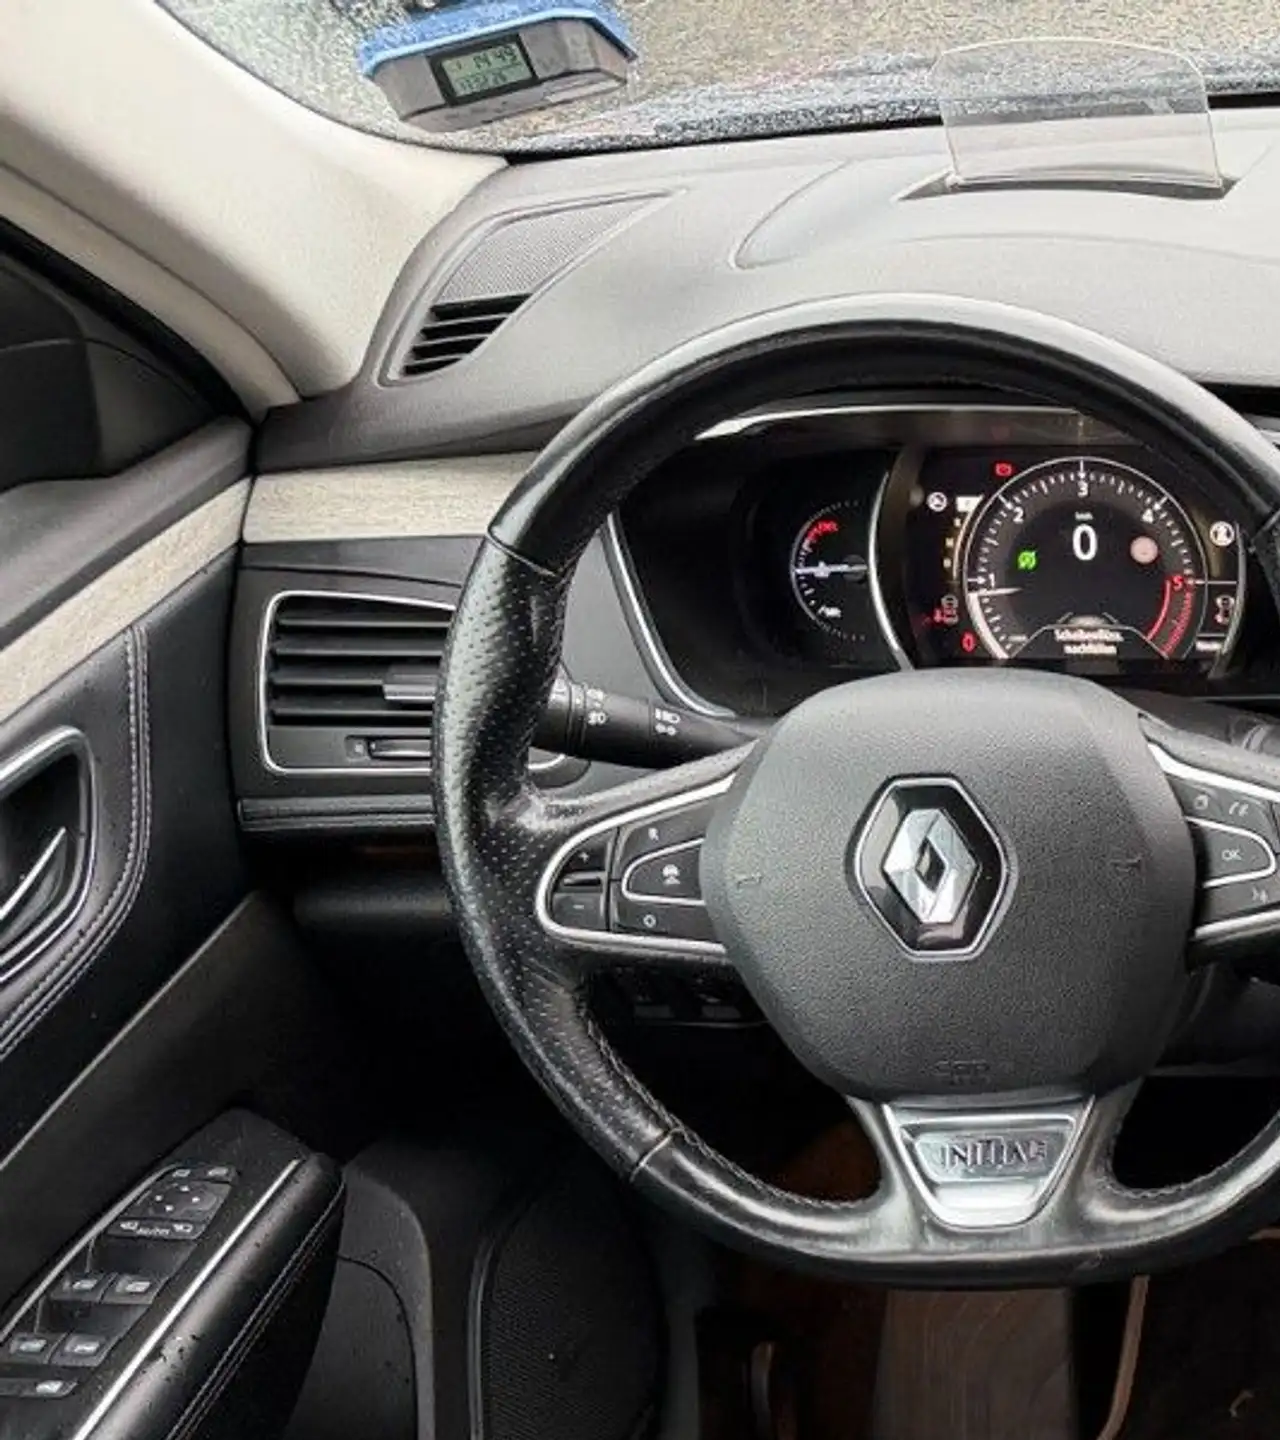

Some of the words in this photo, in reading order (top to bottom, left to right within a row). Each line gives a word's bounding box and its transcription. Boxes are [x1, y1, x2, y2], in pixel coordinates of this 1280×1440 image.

[1077, 482, 1089, 497] 3
[1013, 508, 1025, 523] 2
[1141, 508, 1154, 523] 4
[1072, 523, 1098, 561] 0
[987, 574, 996, 587] 1
[1221, 849, 1242, 862] OK
